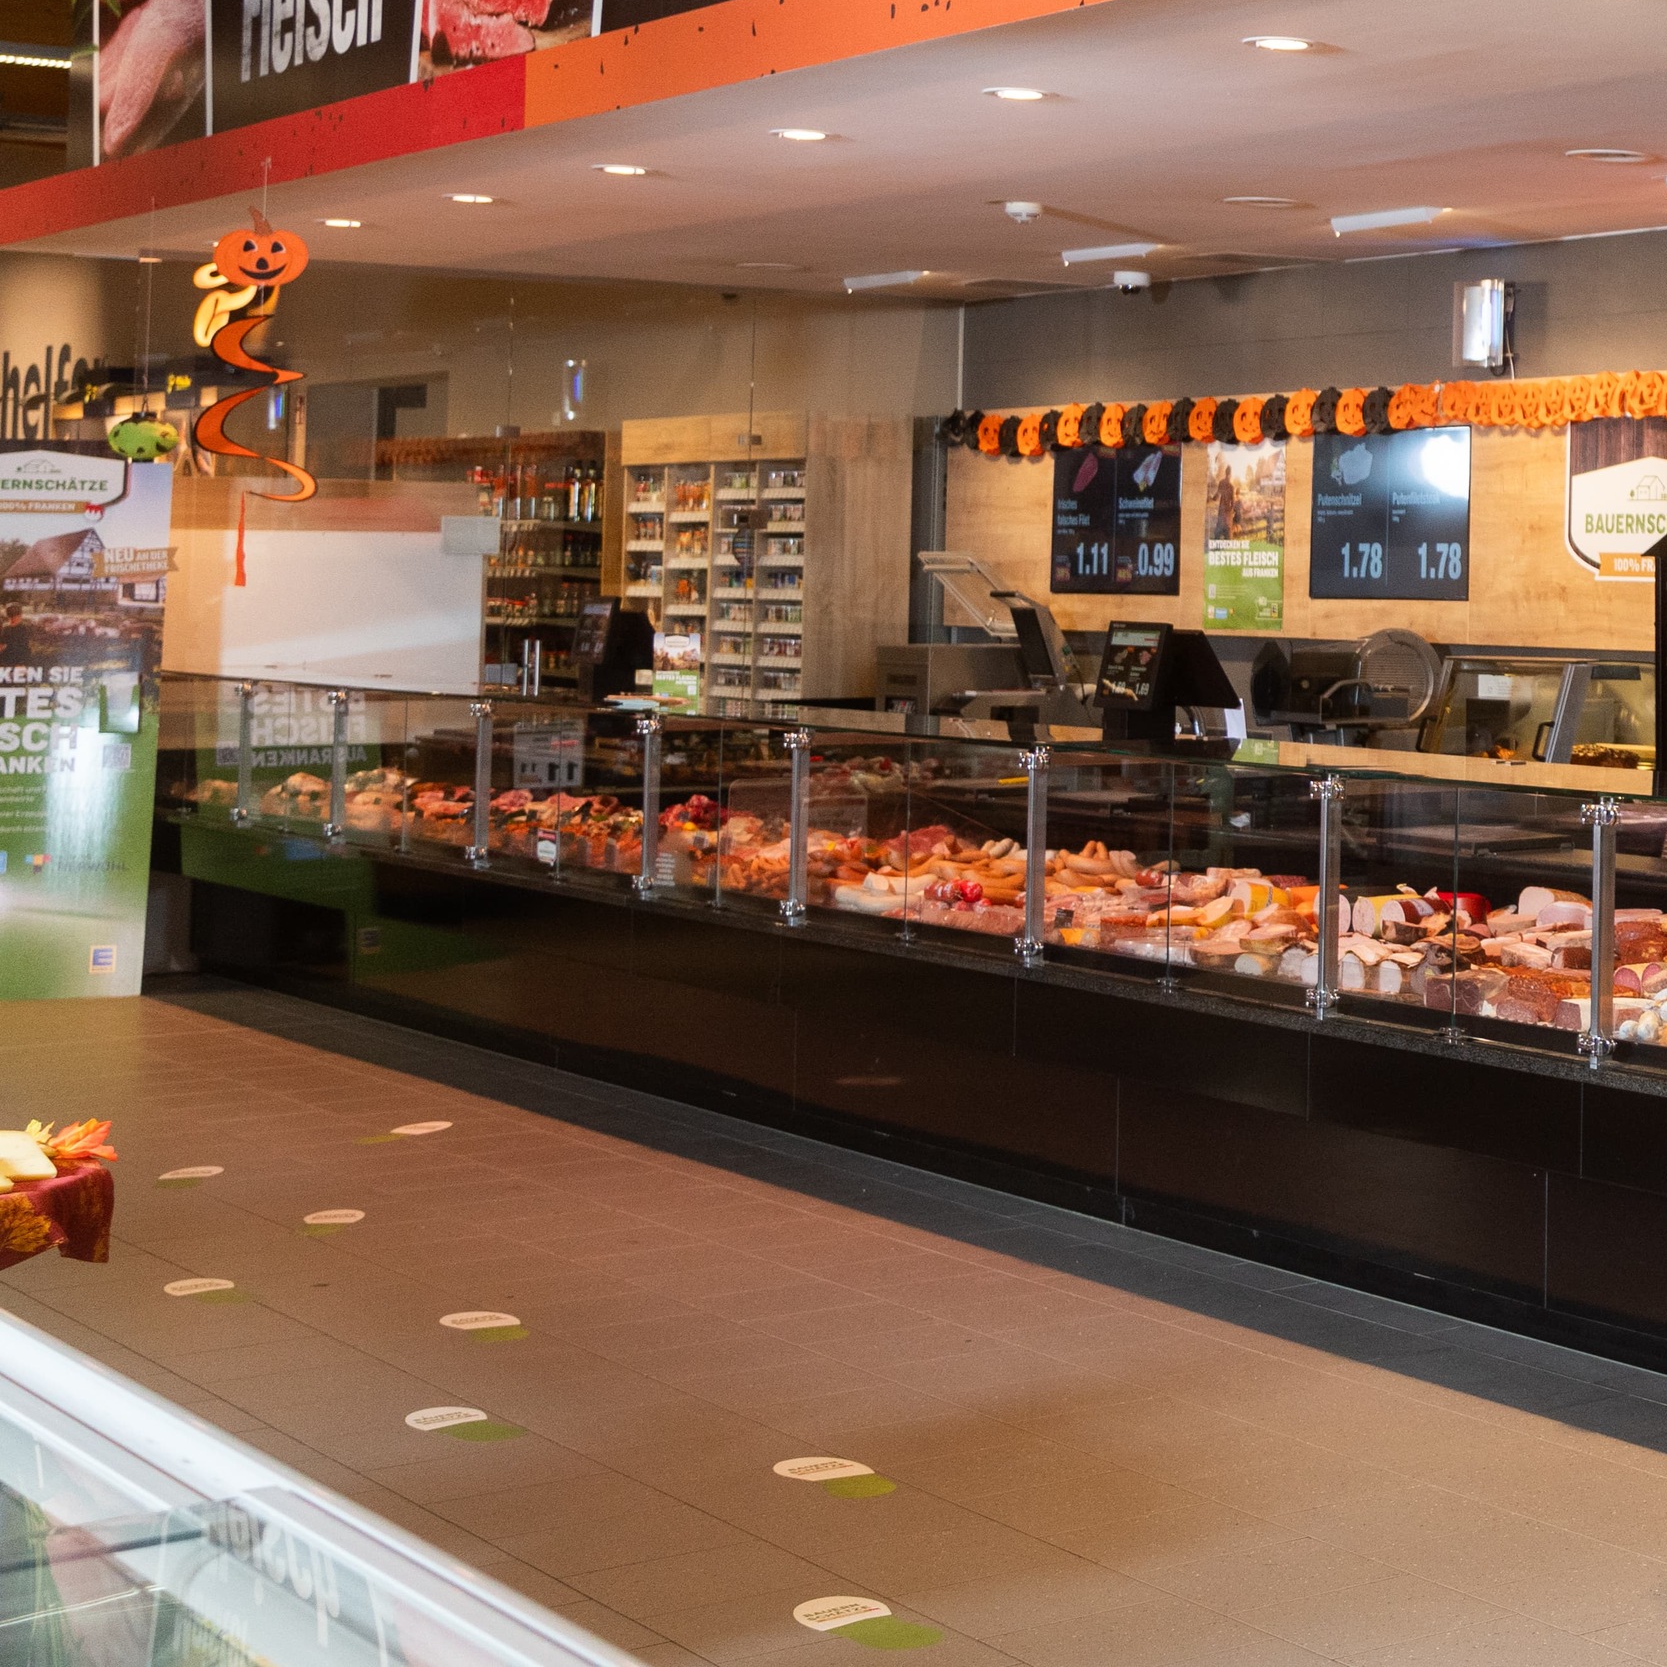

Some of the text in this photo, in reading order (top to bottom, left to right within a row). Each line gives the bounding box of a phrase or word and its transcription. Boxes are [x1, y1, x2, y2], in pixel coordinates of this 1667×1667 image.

[104, 548, 135, 563] NEU
[1076, 541, 1109, 575] 1.11
[1138, 541, 1175, 577] 0.99
[1208, 550, 1279, 566] BESTES FLEISCH
[1341, 542, 1383, 579] 1.78
[1418, 542, 1462, 580] 1.78
[1613, 558, 1640, 573] 100%
[49, 666, 84, 683] SIE
